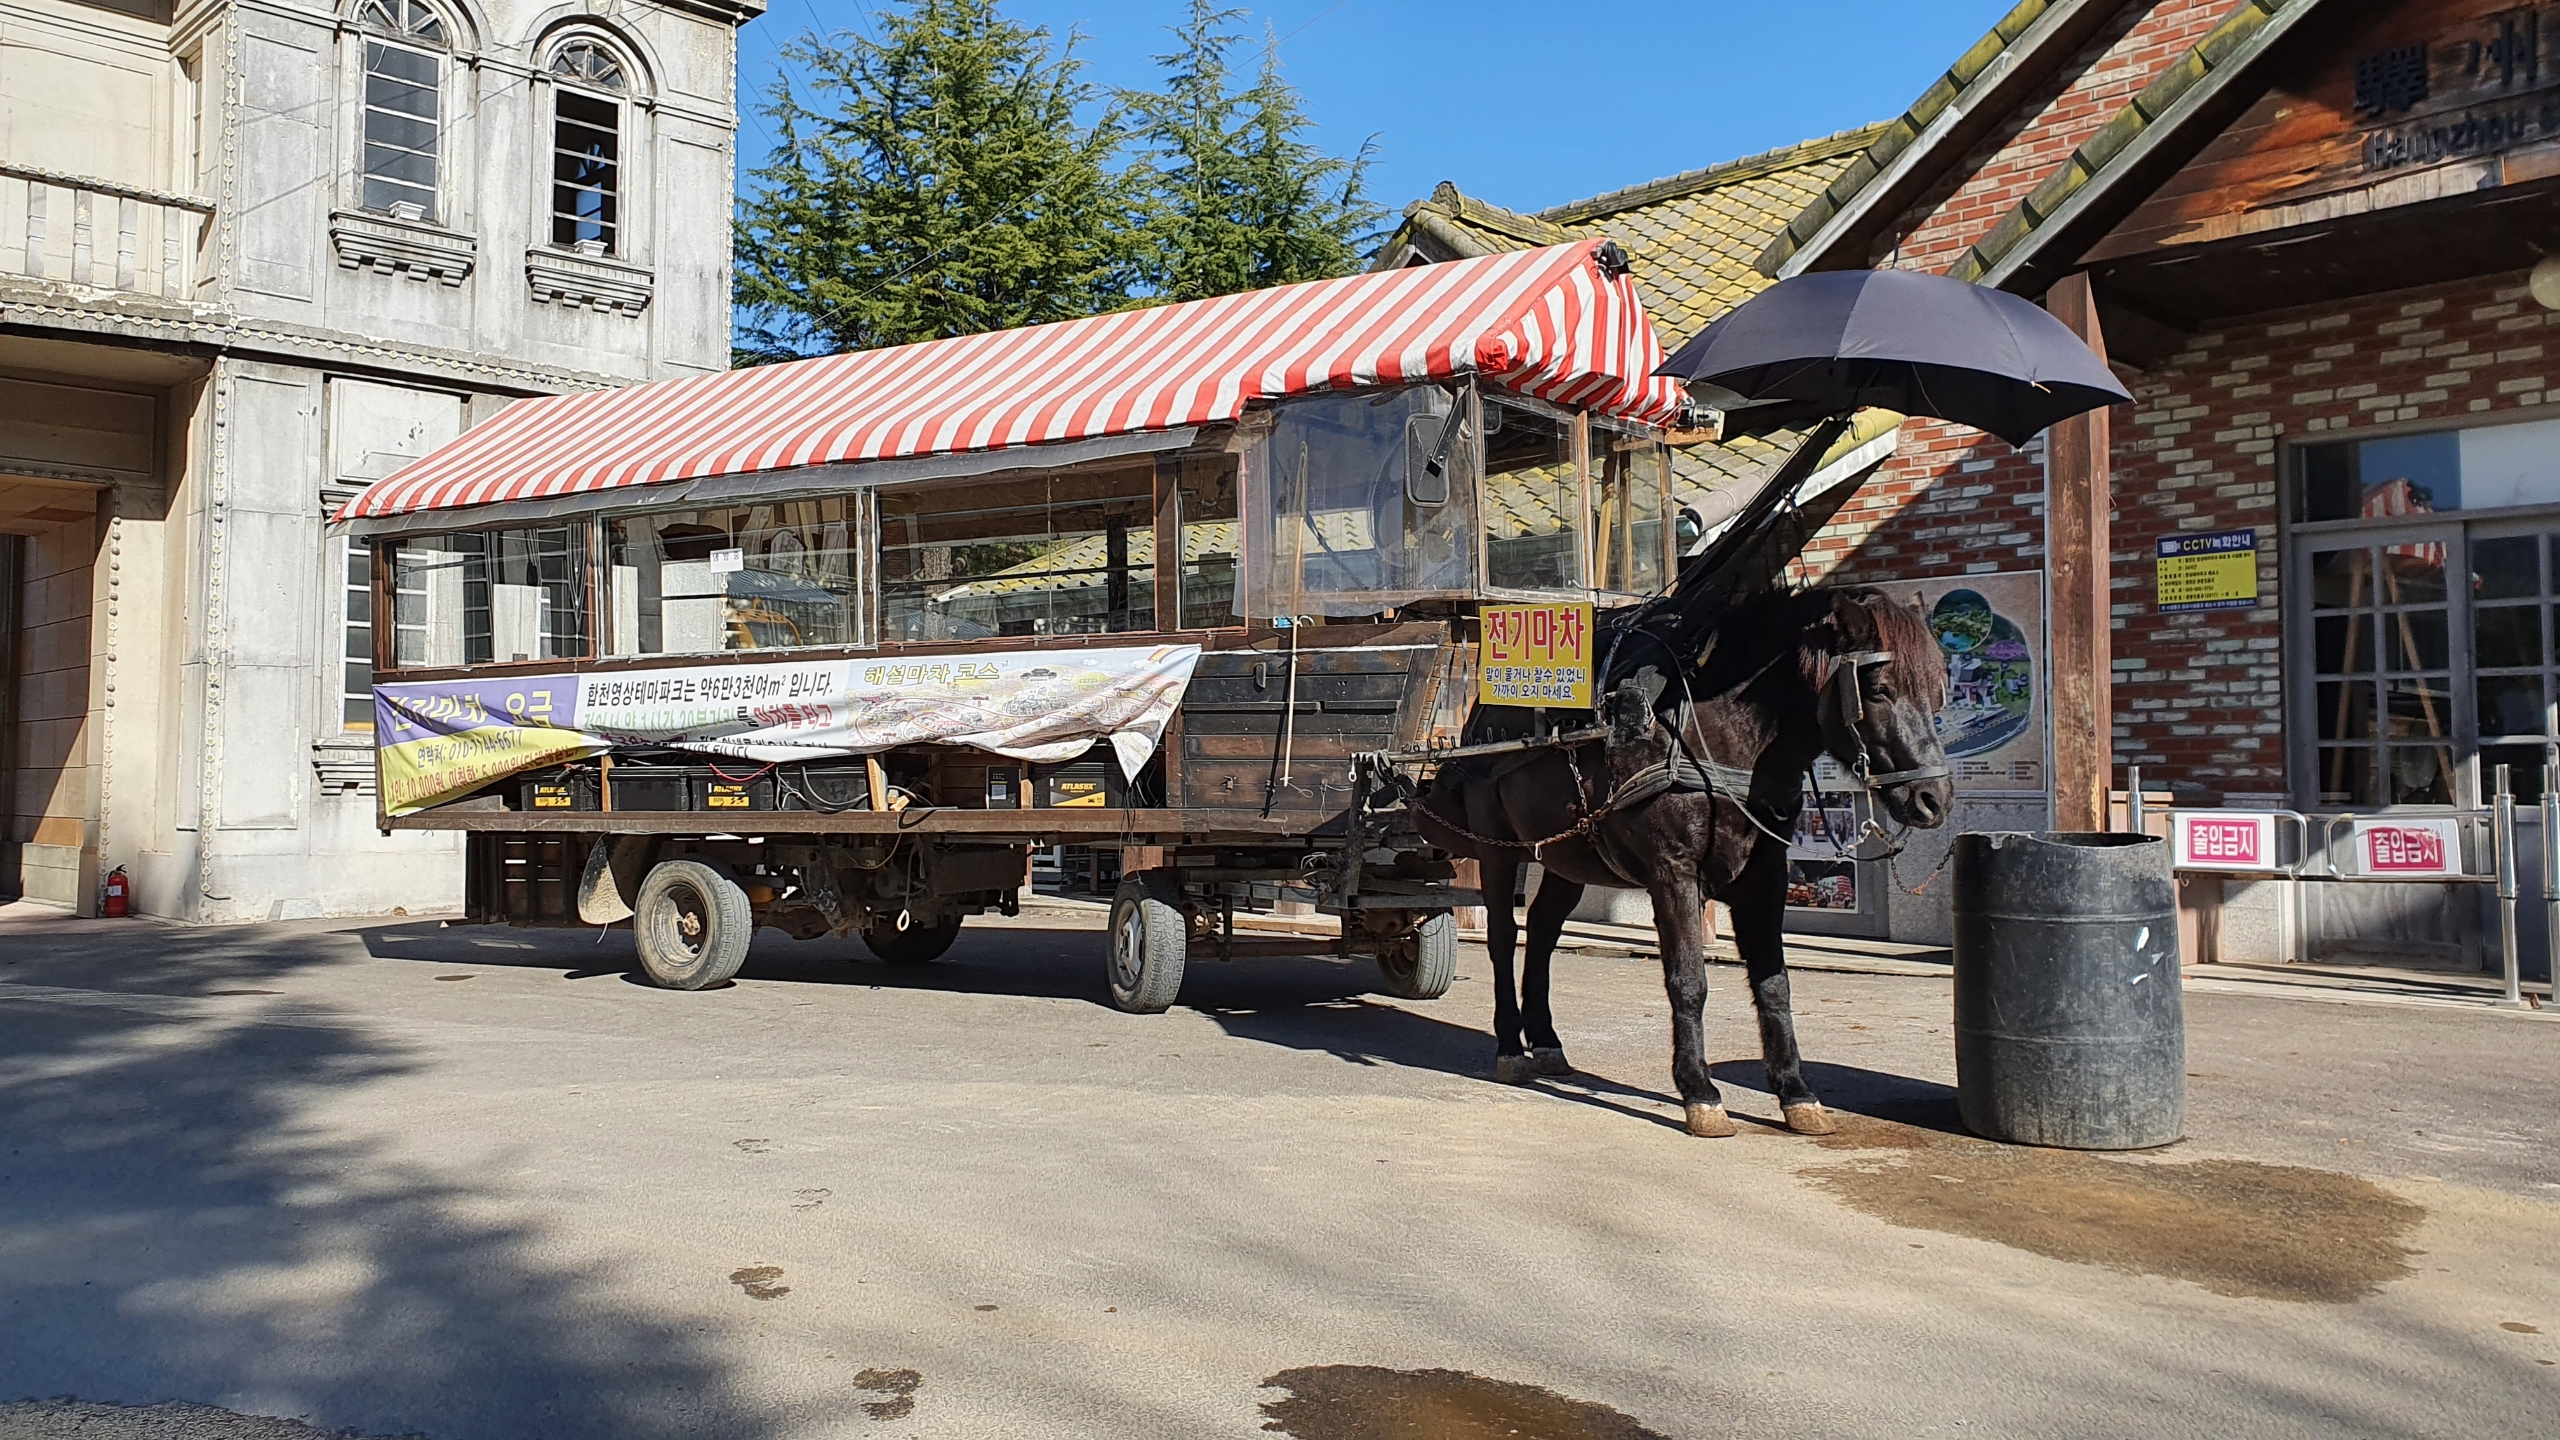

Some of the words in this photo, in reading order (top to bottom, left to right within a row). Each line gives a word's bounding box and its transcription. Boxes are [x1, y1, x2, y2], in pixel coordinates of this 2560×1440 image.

[1487, 607, 1585, 661] 전기마차
[864, 664, 949, 685] 해설마차
[954, 661, 1000, 681] 코스
[1485, 667, 1502, 682] 말이
[1505, 667, 1531, 682] 물거나
[586, 678, 697, 708] 합천영상테마파크는
[788, 671, 833, 698] 입니다.
[1492, 683, 1519, 698] 가까이
[1521, 684, 1539, 699] 오지
[1542, 684, 1575, 700] 마세요.
[505, 690, 554, 729] 요금
[418, 743, 447, 769] 연락처:
[2192, 824, 2254, 858] 출입금지
